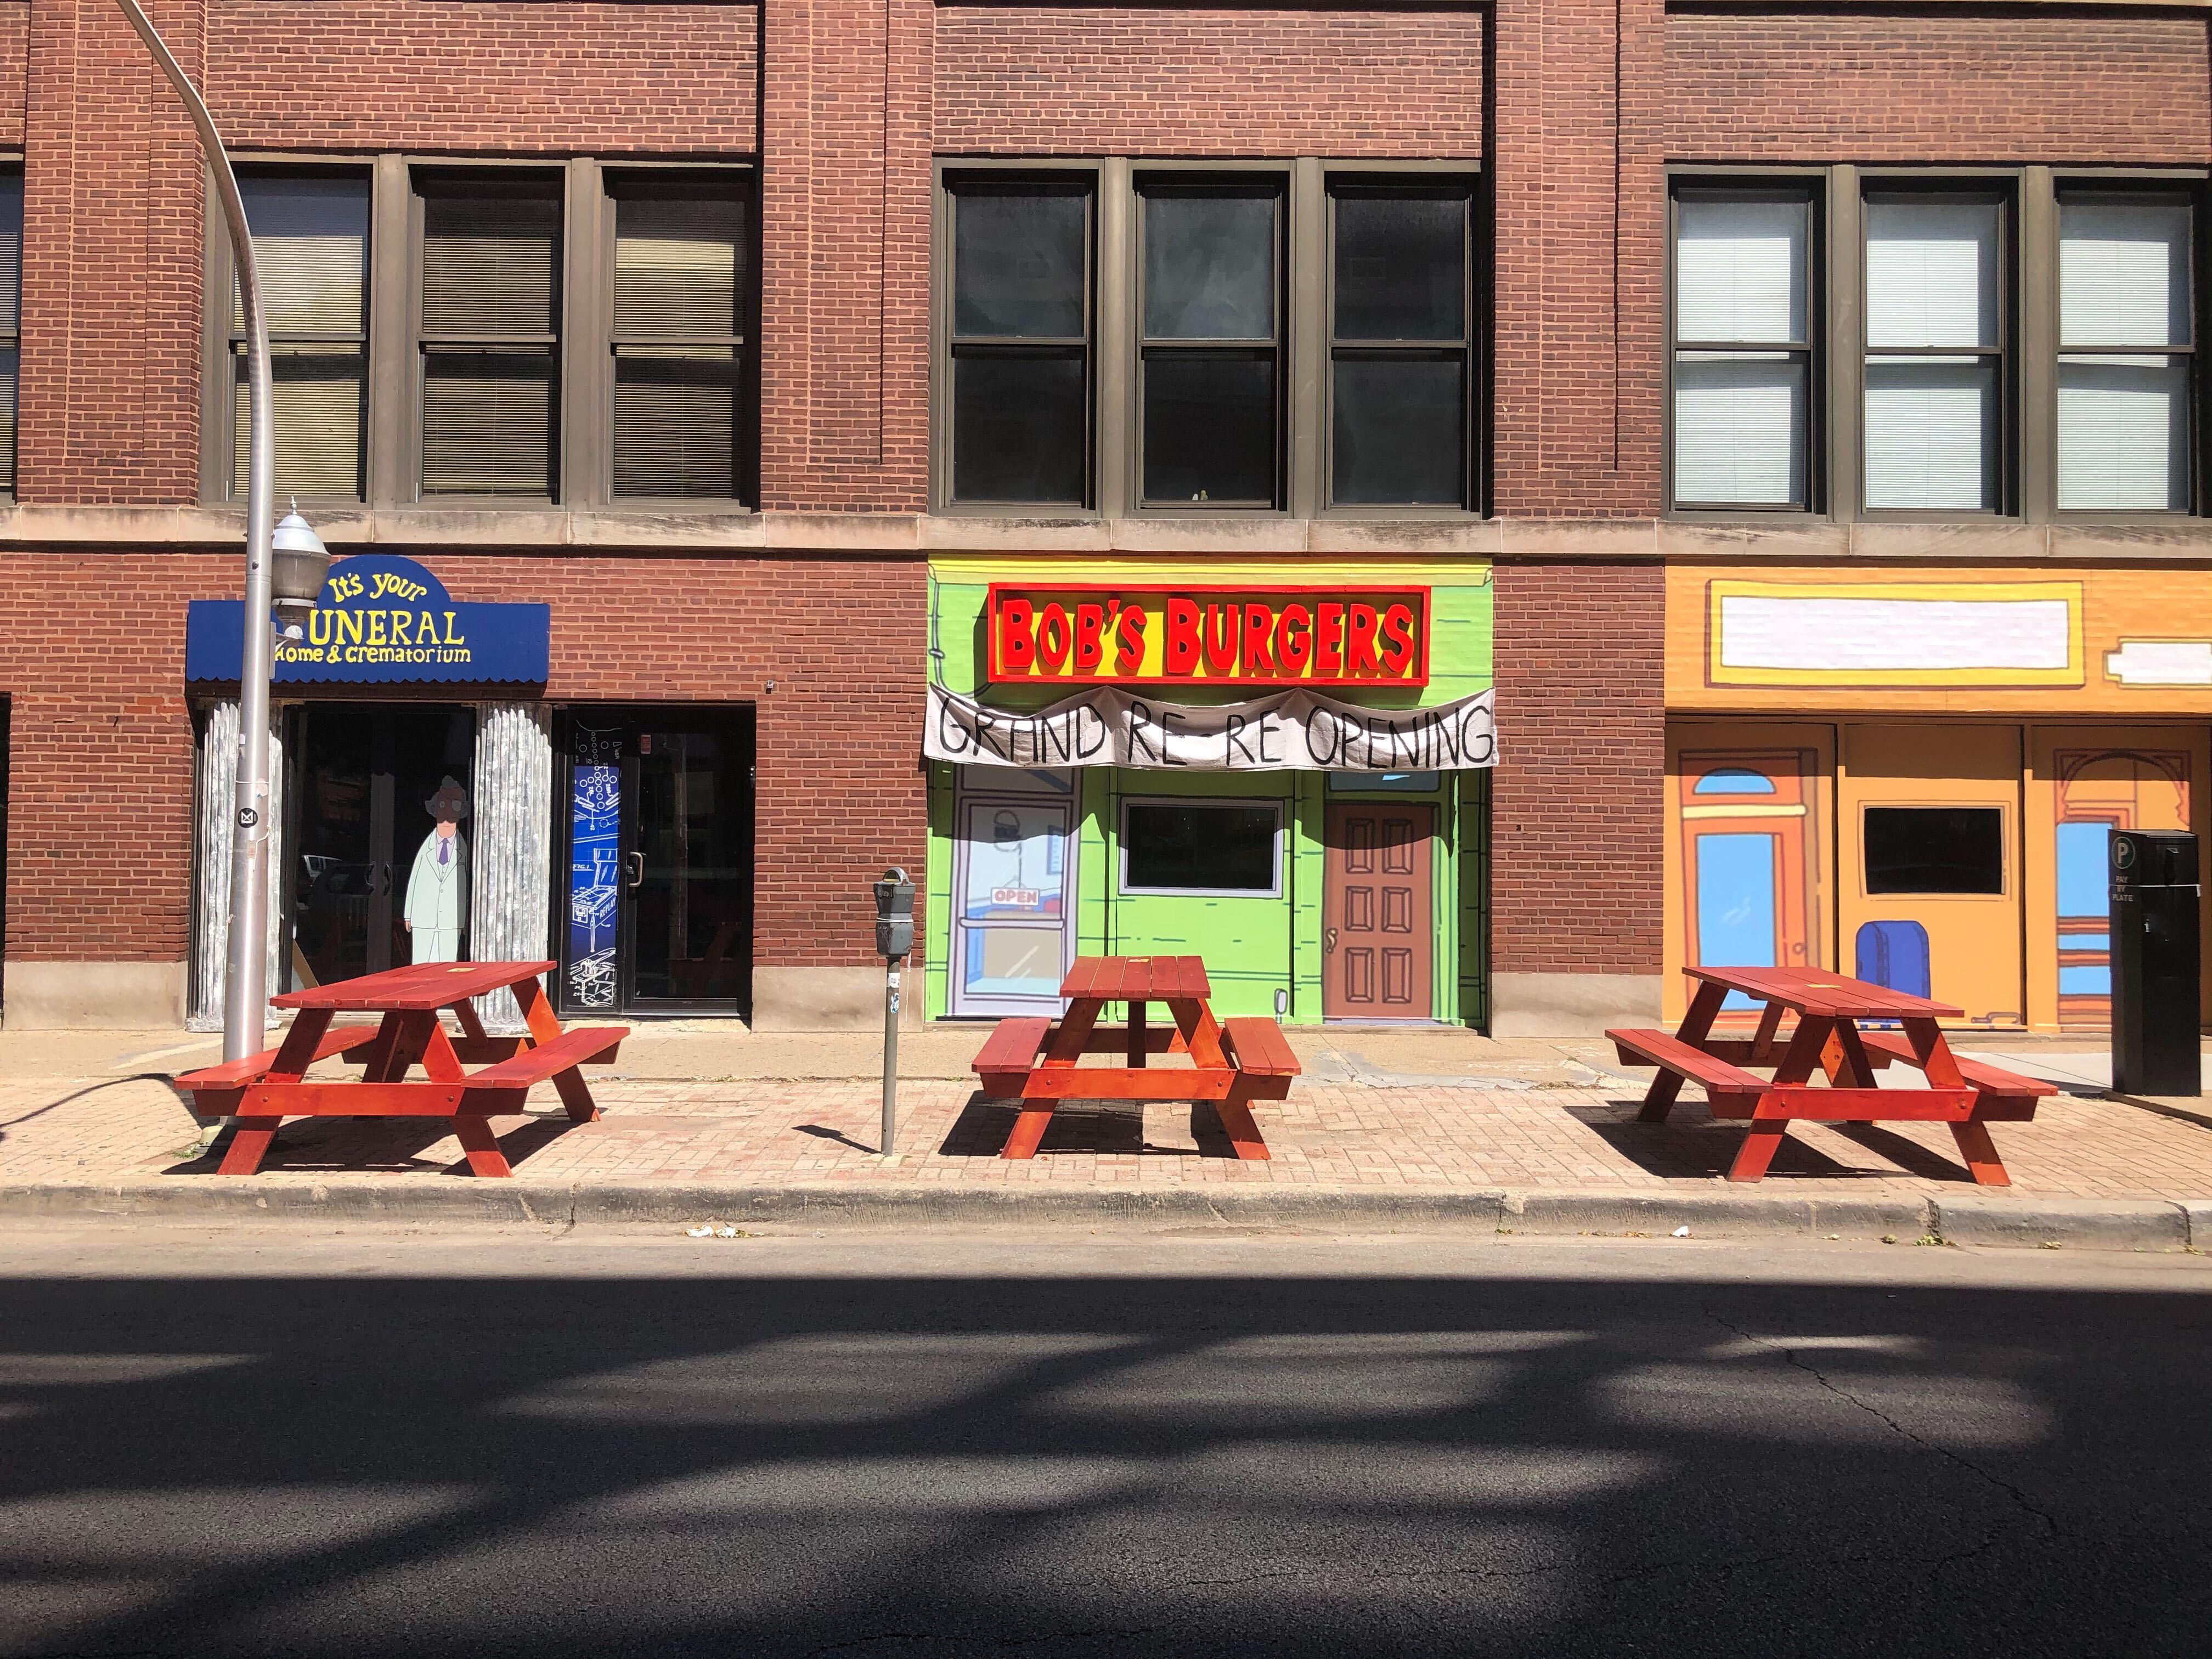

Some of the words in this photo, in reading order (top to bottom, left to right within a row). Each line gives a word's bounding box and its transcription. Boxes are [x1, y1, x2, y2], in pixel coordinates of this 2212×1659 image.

[328, 573, 363, 602] It's
[370, 573, 427, 602] your
[309, 609, 464, 645] UNERAL
[1002, 599, 1147, 670] BOB'S
[1166, 597, 1414, 673] BURGERS
[326, 645, 343, 664] &
[939, 697, 1106, 763] GRAND
[1305, 706, 1493, 768] OPENING
[2118, 843, 2128, 864] P
[600, 896, 616, 919] REPLAY
[995, 890, 1037, 903] OPEN
